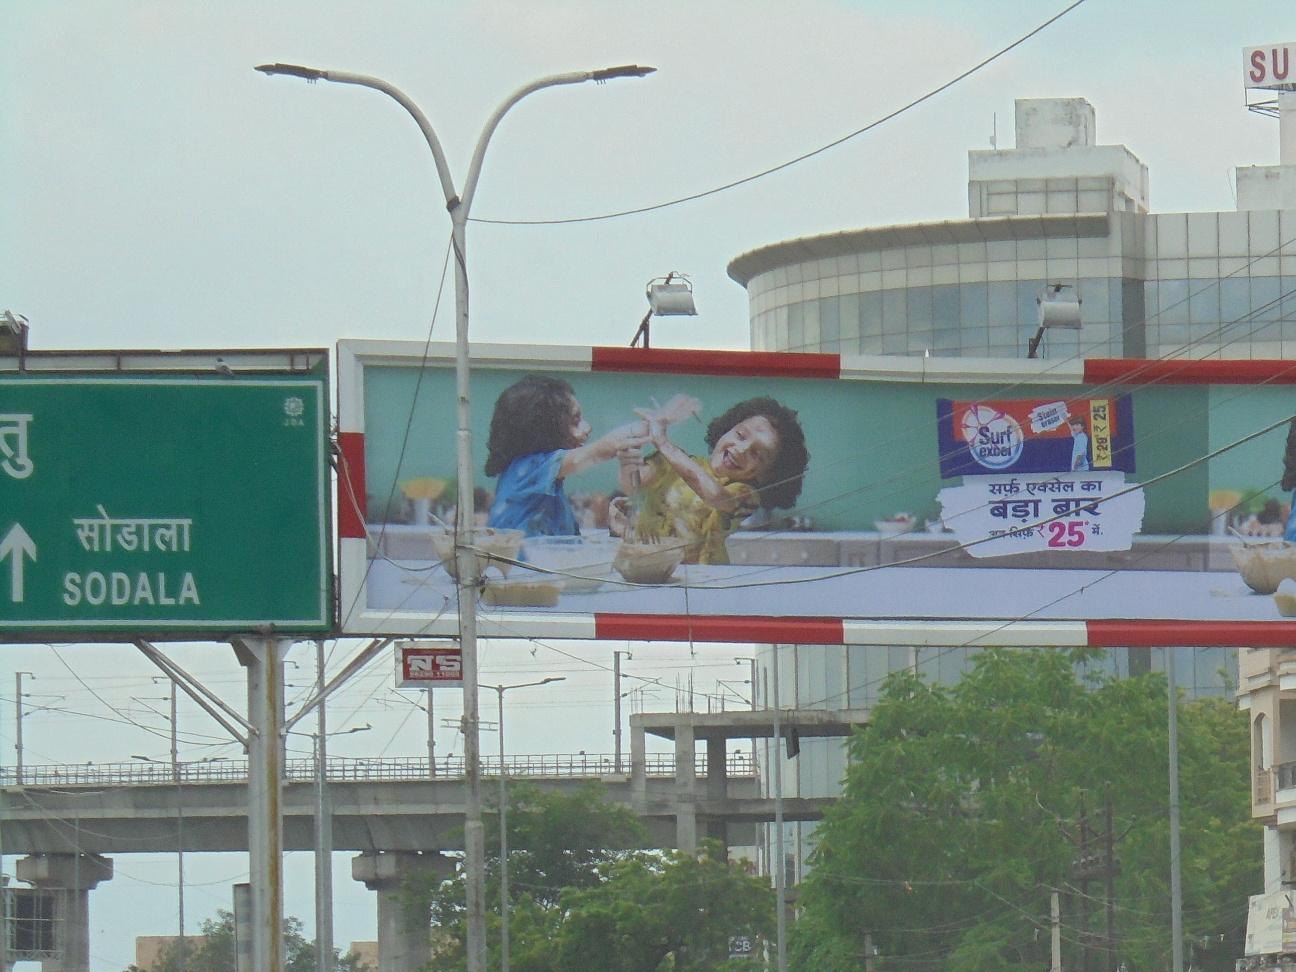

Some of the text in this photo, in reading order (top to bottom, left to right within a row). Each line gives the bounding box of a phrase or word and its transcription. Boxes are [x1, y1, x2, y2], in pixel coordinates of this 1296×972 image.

[978, 424, 1013, 445] Surf
[1080, 480, 1103, 492] का
[989, 496, 1103, 523] बड़ा बार
[73, 504, 193, 552] सोडाला
[63, 572, 200, 606] SODALA
